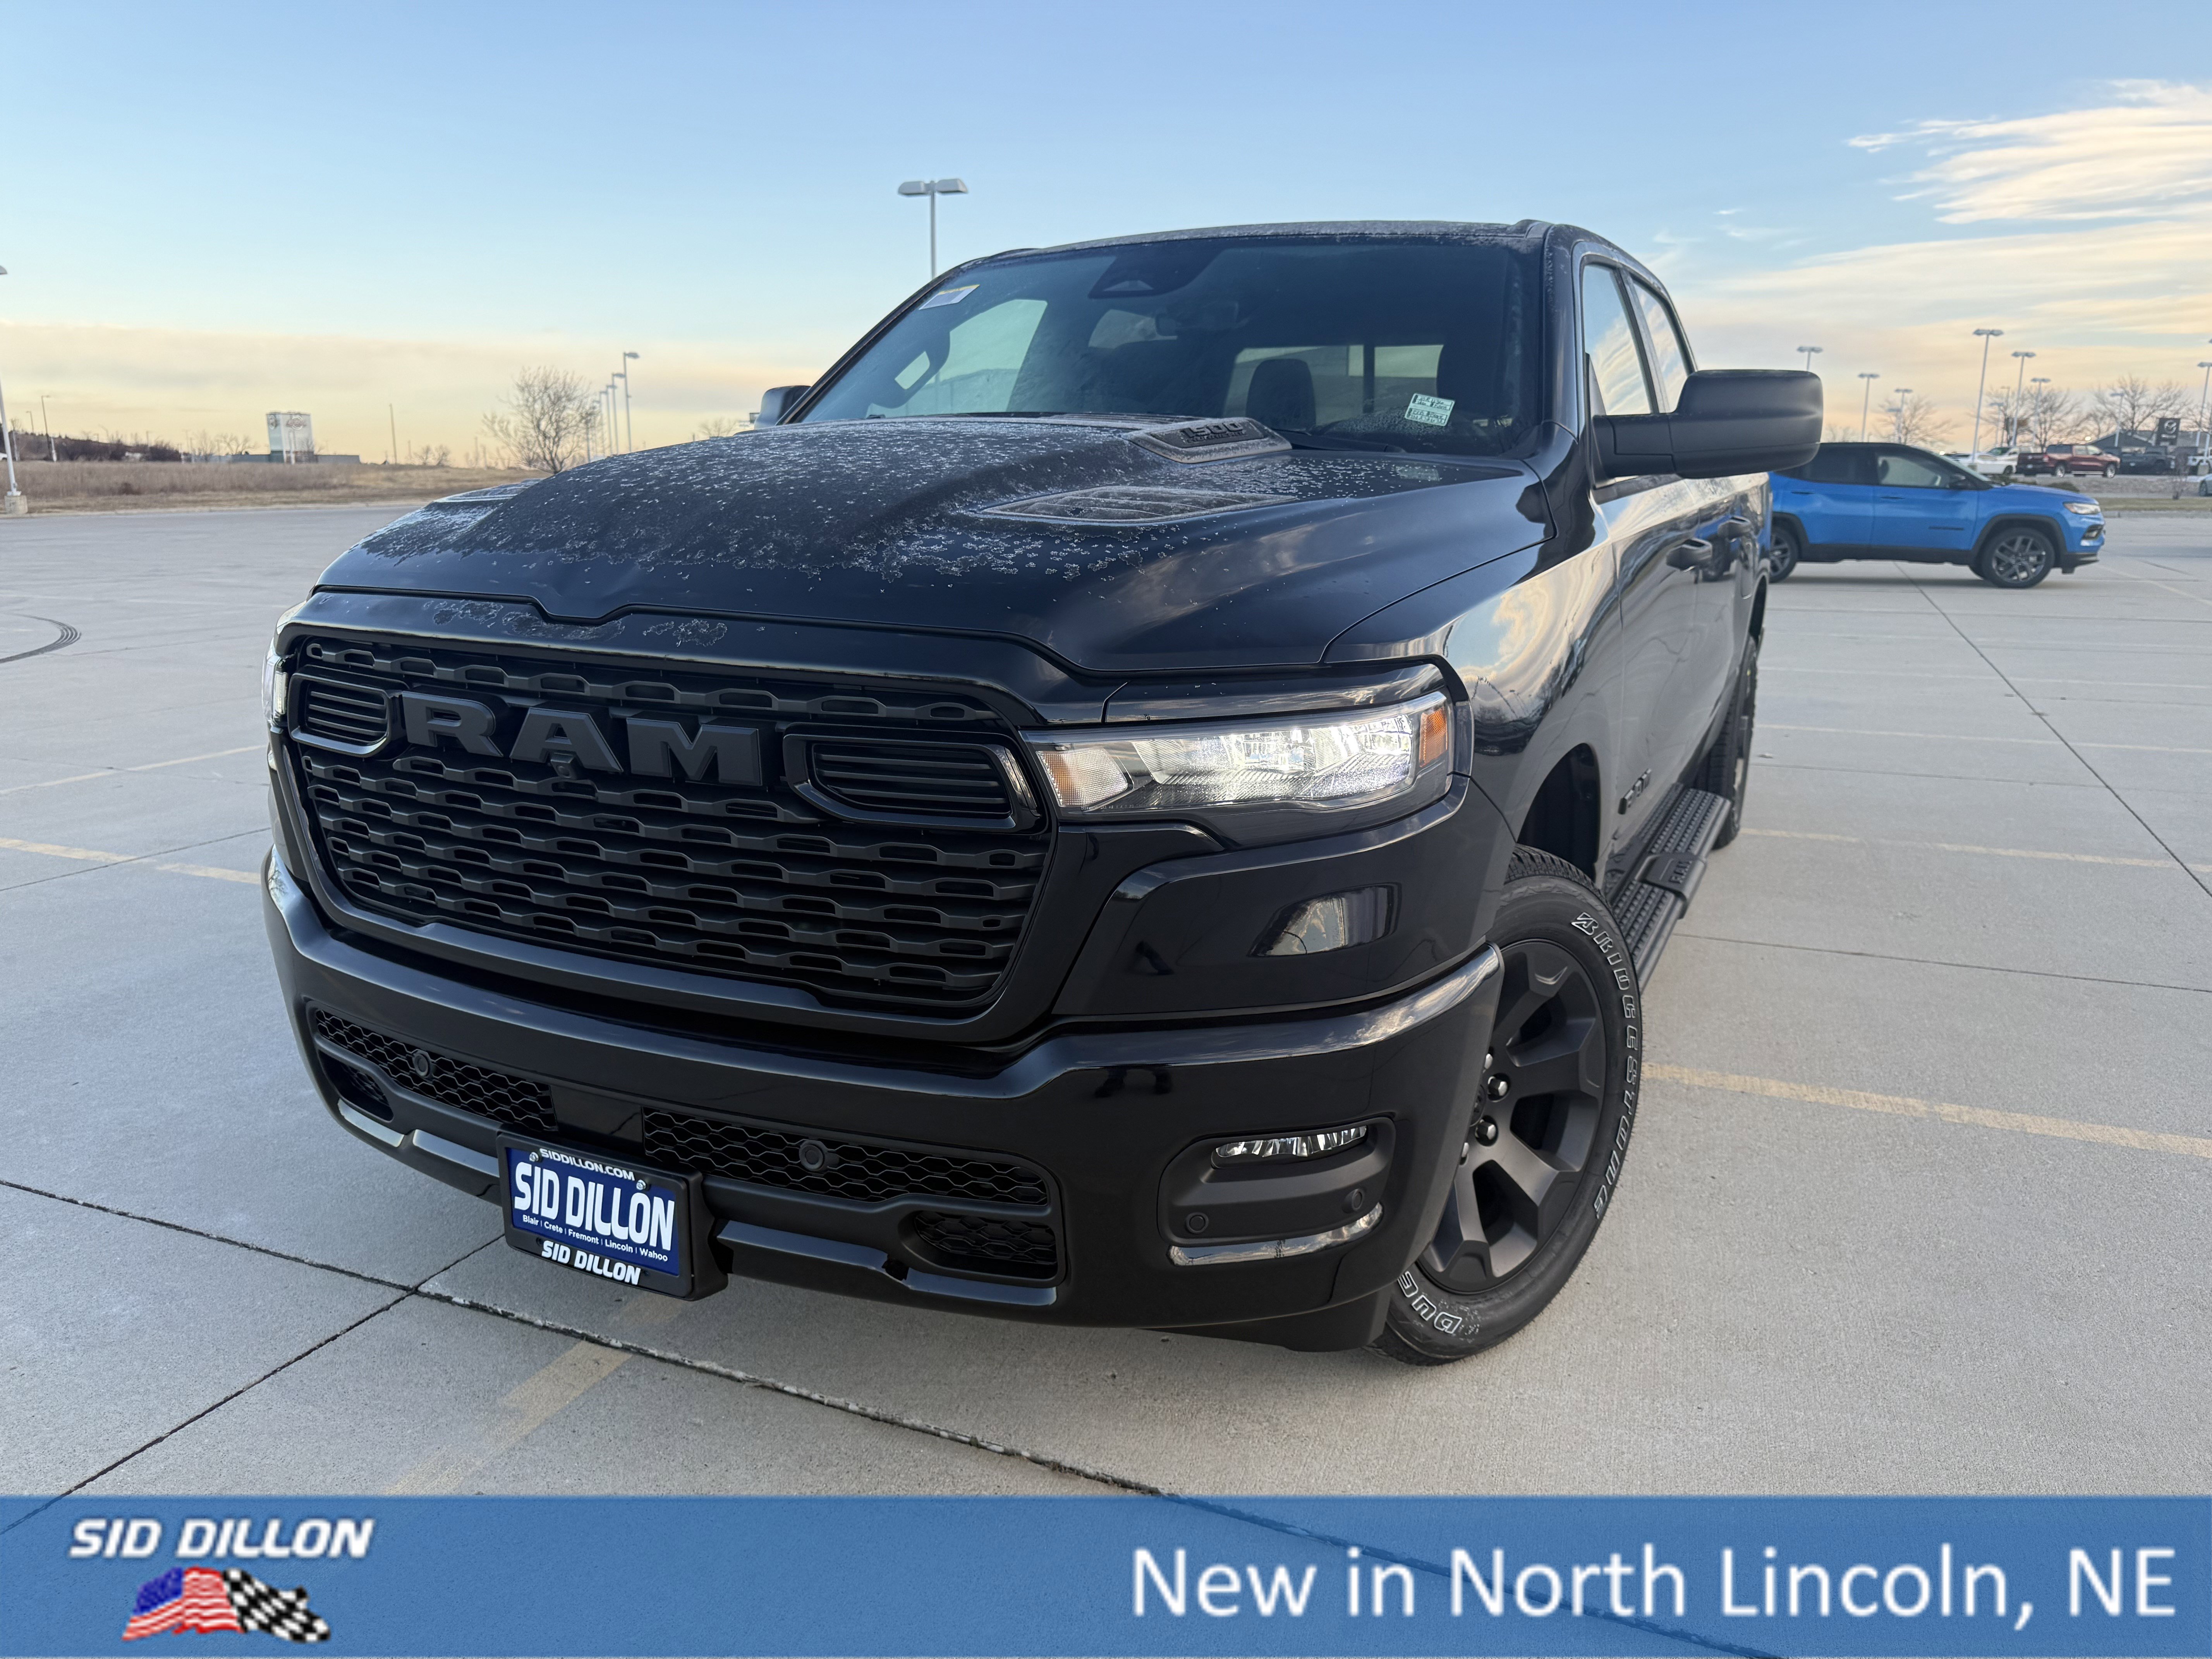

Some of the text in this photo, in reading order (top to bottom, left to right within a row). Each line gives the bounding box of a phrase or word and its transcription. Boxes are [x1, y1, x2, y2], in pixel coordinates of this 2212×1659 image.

[1180, 421, 1243, 438] 1500
[402, 690, 763, 787] RAM
[1571, 912, 1638, 1219] BRIDGESTONE
[539, 1148, 635, 1181] SIDDILLON.COM
[514, 1161, 675, 1251] SID DILLON
[523, 1214, 668, 1262] Blair Crete Fremont Lincoln Wahoo
[541, 1240, 641, 1285] SID DILLON
